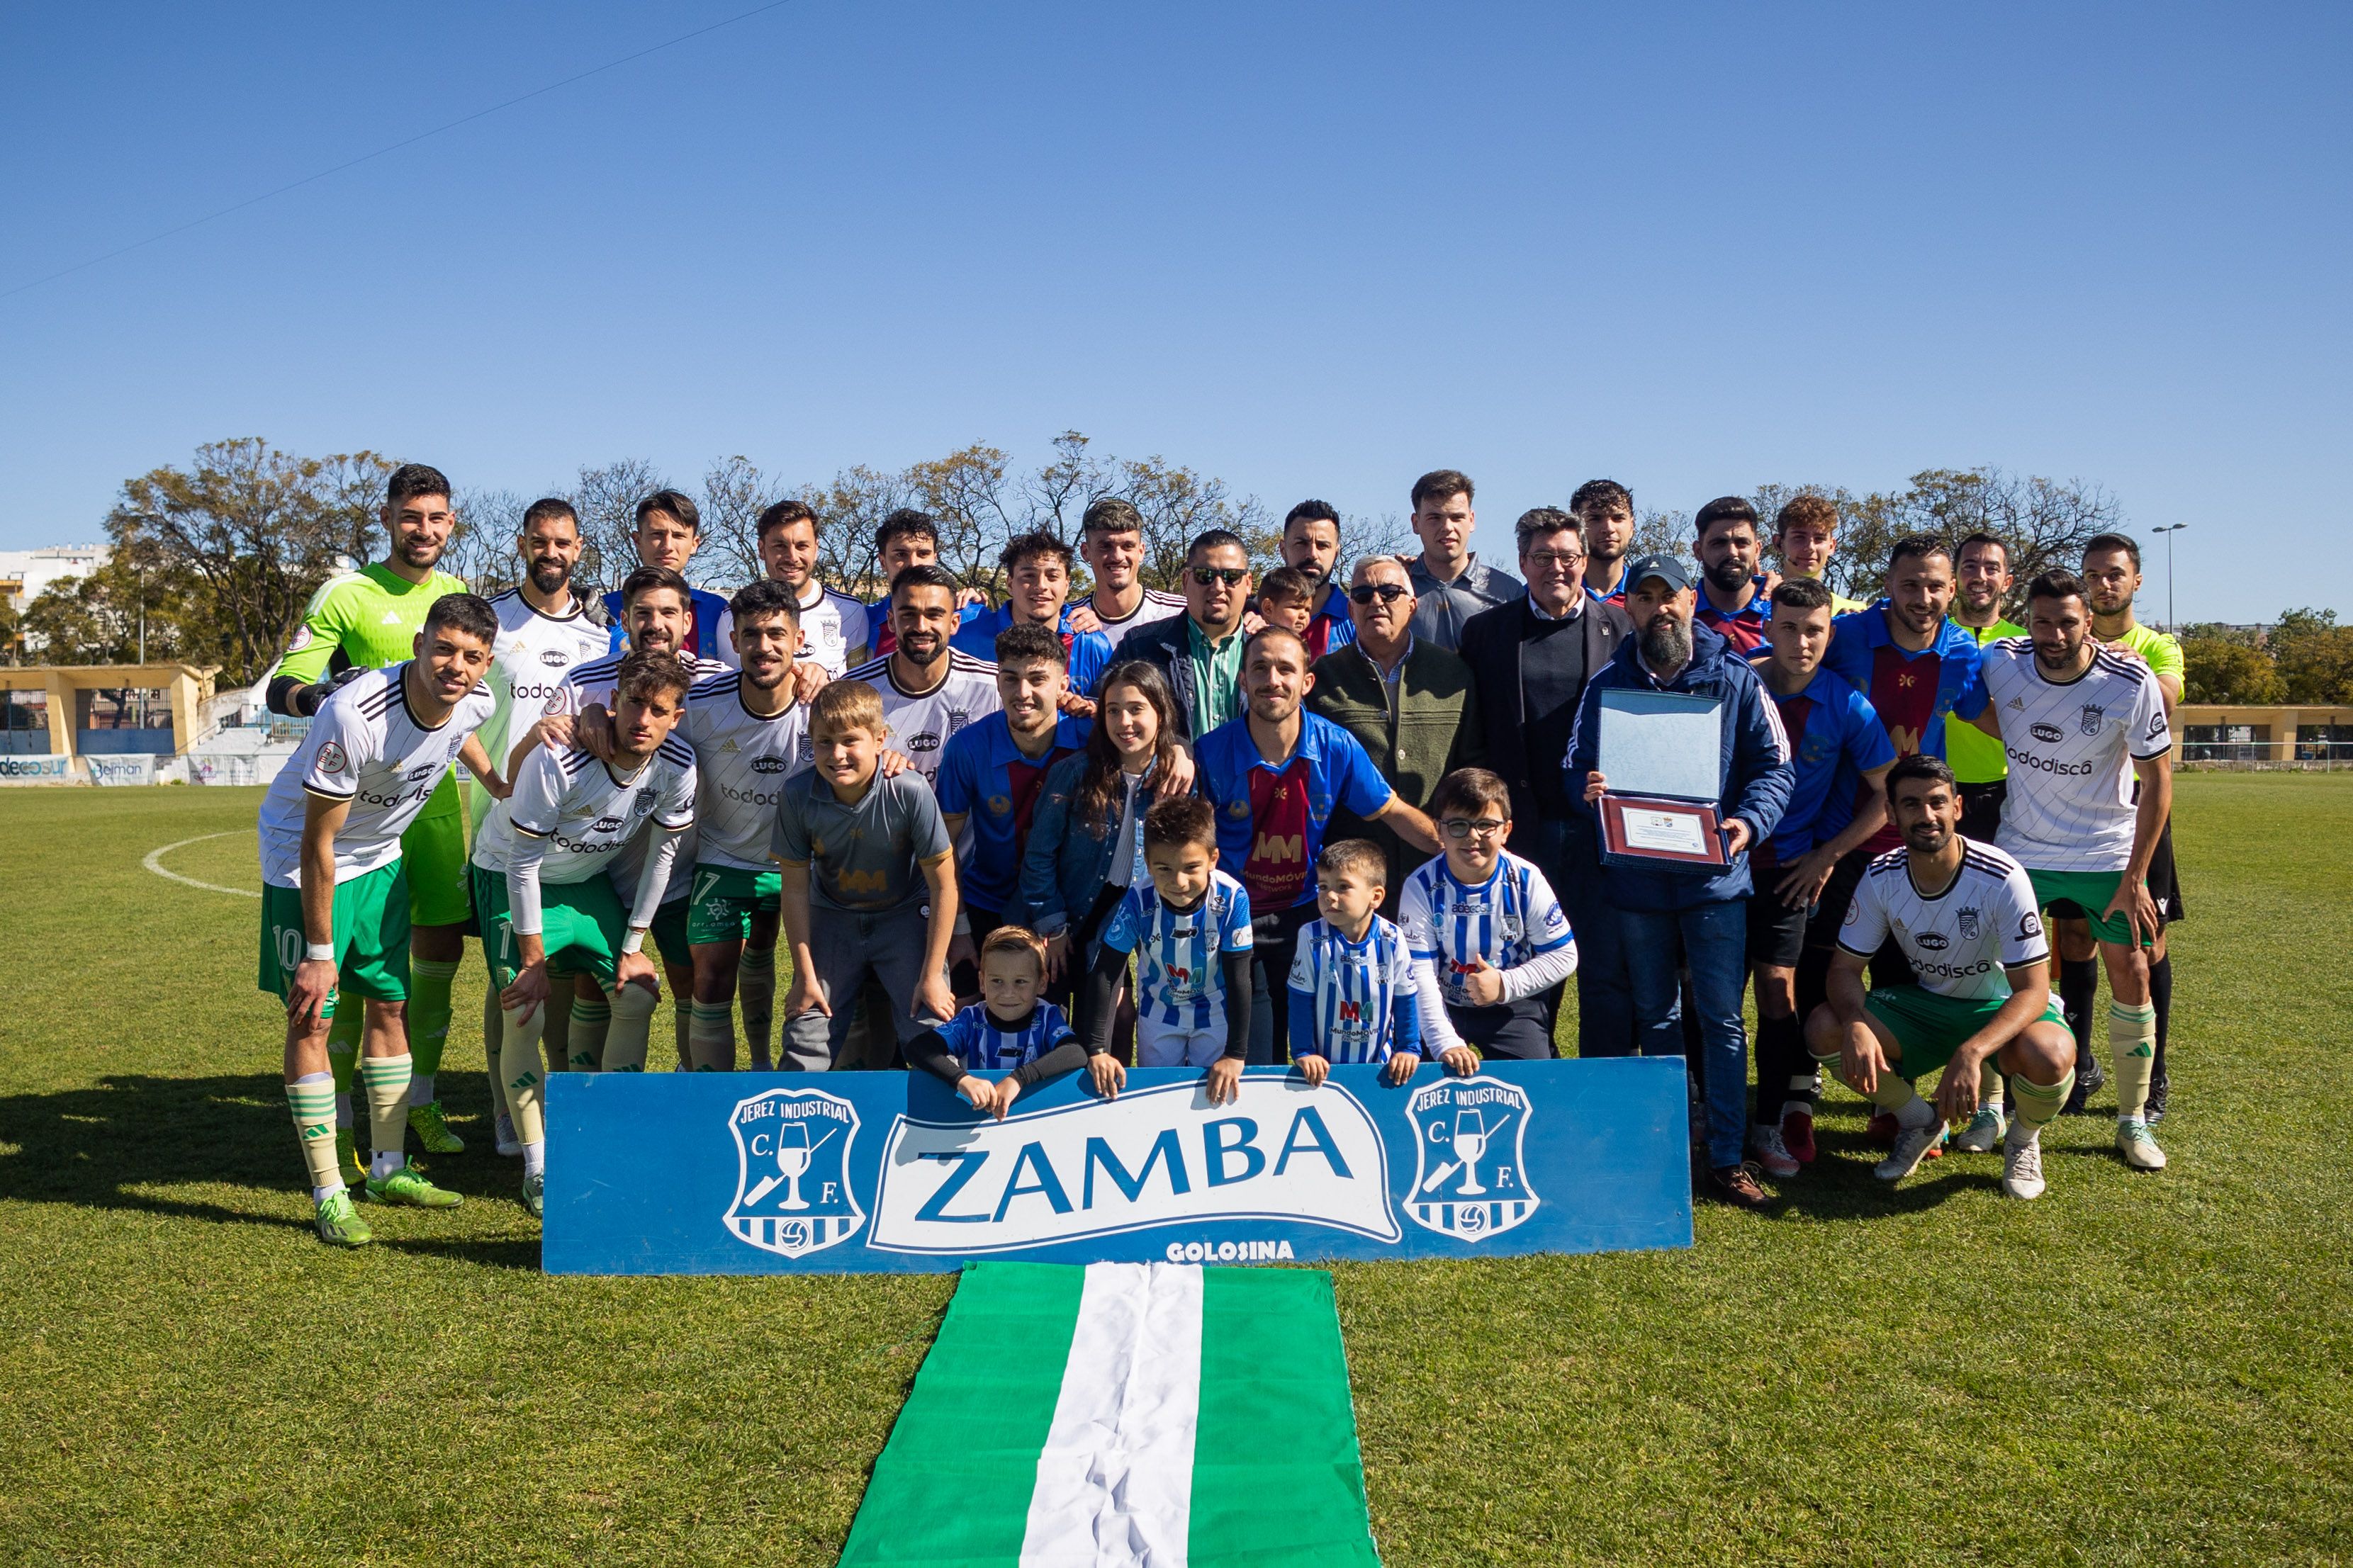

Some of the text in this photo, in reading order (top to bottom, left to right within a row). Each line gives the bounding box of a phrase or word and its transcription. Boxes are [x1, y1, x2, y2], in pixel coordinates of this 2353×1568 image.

[540, 655, 568, 664] LUGO
[909, 739, 938, 749] LUGO
[2031, 728, 2062, 740] LUGO
[753, 762, 785, 771] LUGO
[690, 871, 721, 905] 17
[272, 925, 302, 971] 10
[1916, 938, 1948, 947] LUGO
[1340, 1000, 1374, 1022] MM
[1417, 1088, 1522, 1112] JEREZ INDUSTRIAL
[741, 1100, 849, 1124] JEREZ INDUSTRIAL
[1428, 1121, 1450, 1143] C.
[751, 1134, 773, 1156] C.
[914, 1105, 1354, 1223] ZAMBA
[1495, 1167, 1514, 1188] F.
[820, 1182, 838, 1204] F.
[1167, 1241, 1294, 1261] GOLOSINA
